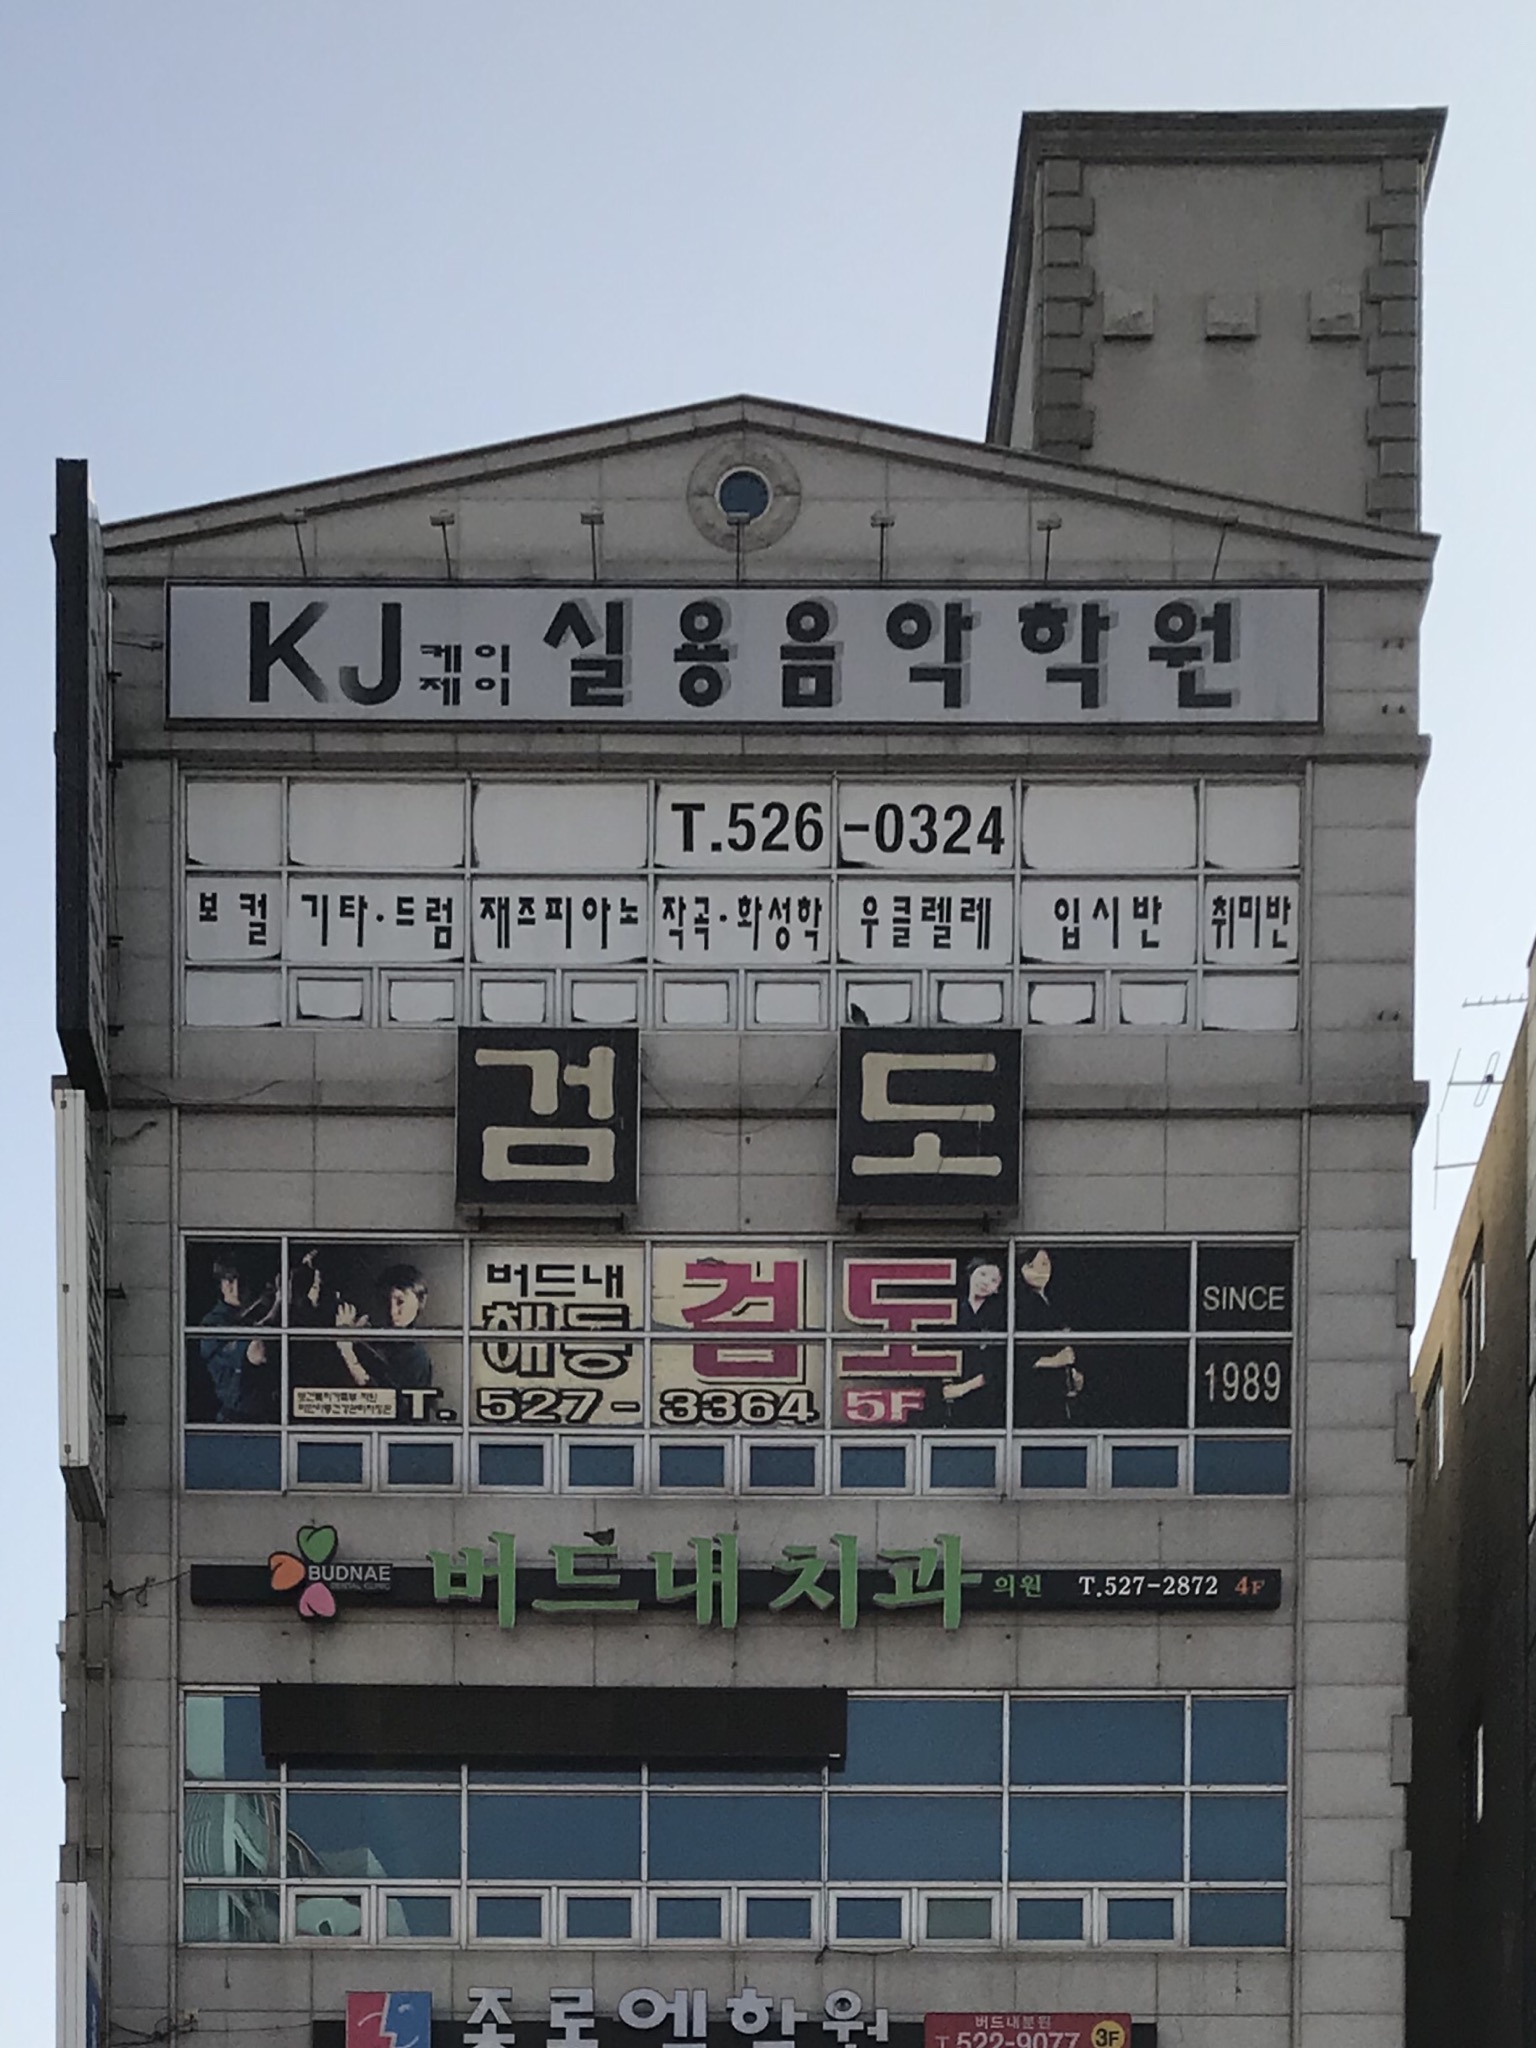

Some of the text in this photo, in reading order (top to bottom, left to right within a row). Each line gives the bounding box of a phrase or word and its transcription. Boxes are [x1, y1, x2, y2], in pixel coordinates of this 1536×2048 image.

[249, 600, 1236, 709] KJ 실용음악학원
[419, 644, 510, 673] 케이
[419, 676, 510, 706] 제이
[671, 801, 1005, 855] T.526-0324
[199, 893, 268, 946] 보컬
[480, 896, 639, 949] 재즈피아노
[861, 896, 991, 950] 우클렐레
[1054, 896, 1162, 950] 입시반
[1211, 896, 1291, 950] 취미반
[486, 1263, 625, 1299] 버드내
[1203, 1286, 1286, 1311] SINCE
[481, 1302, 634, 1379] 해동
[1204, 1362, 1282, 1402] 1989
[845, 1388, 927, 1424] 5F
[308, 1565, 391, 1581] BUDNAE
[426, 1531, 1265, 1630] 버드내치과 의원 T.527-2872 4F
[1095, 2028, 1119, 2047] 3F
